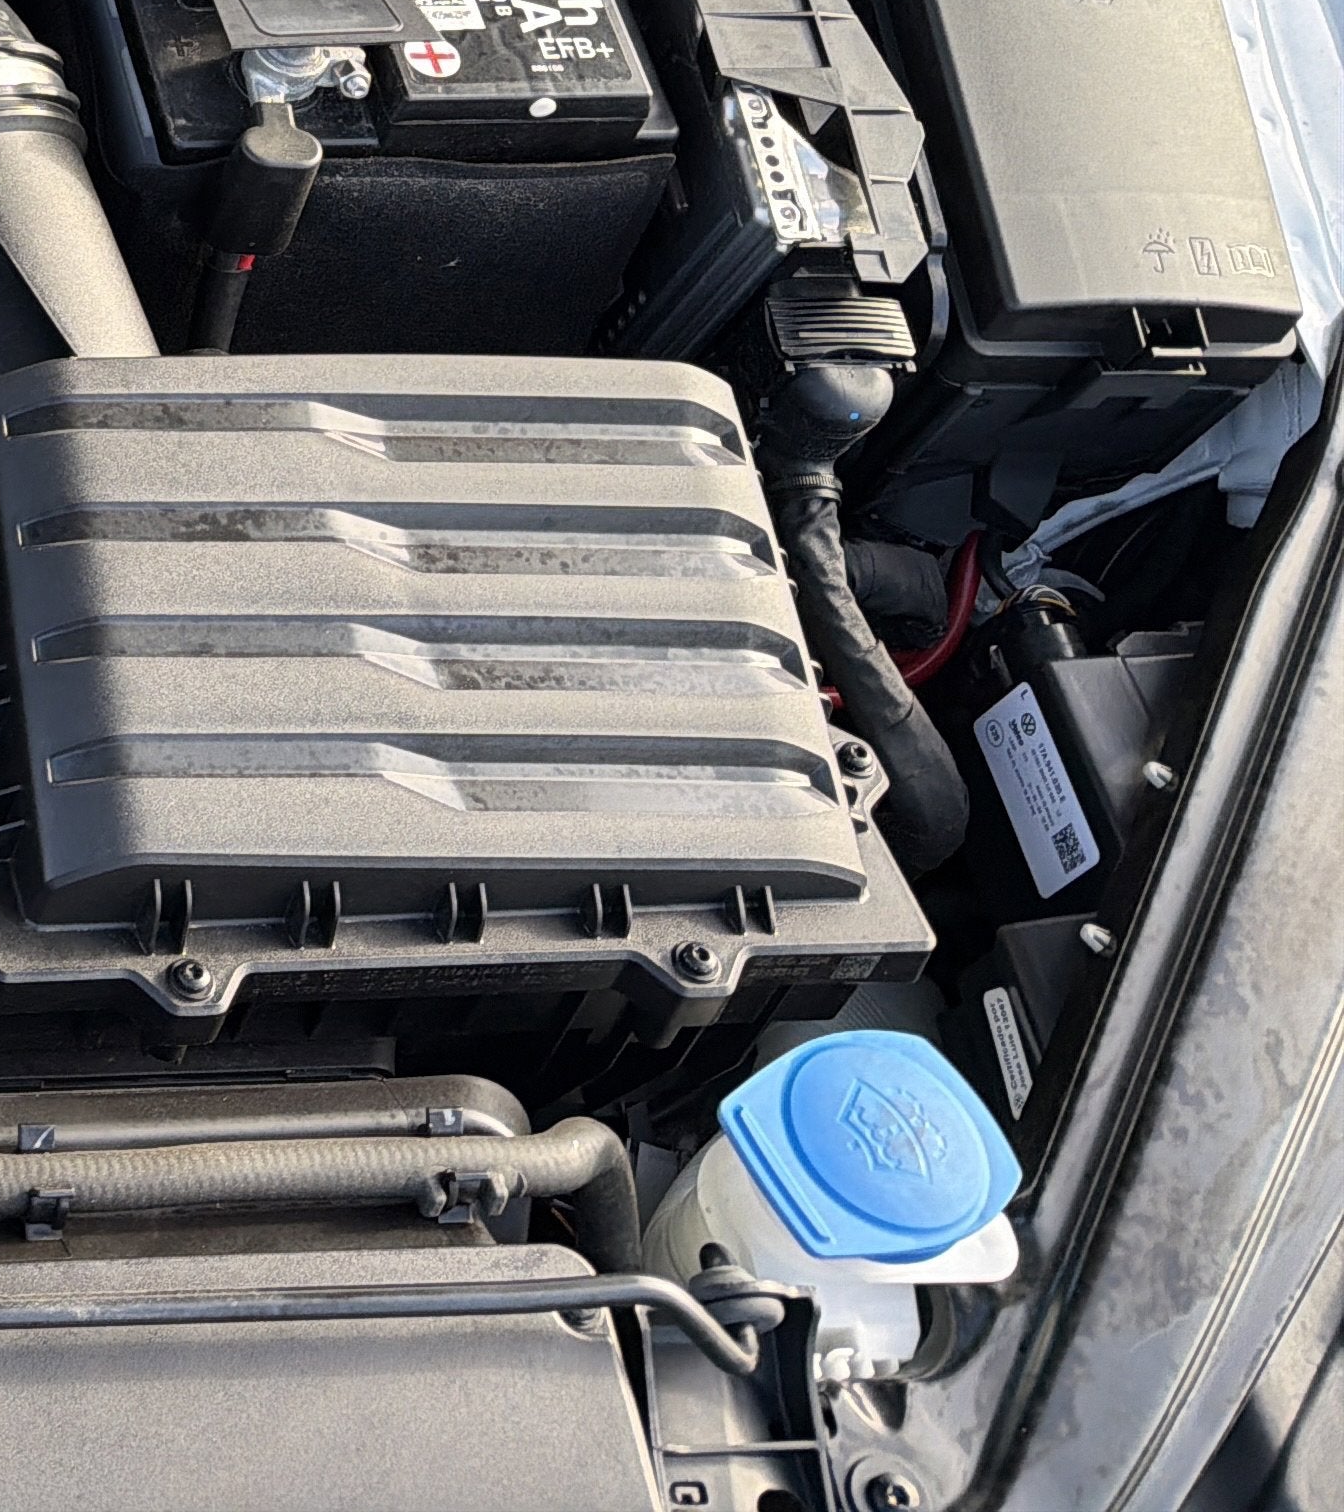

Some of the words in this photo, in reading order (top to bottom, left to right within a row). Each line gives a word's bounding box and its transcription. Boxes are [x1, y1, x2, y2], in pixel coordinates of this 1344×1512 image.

[495, 5, 512, 16] B
[537, 36, 614, 60] EFB+
[989, 1001, 1000, 1023] por
